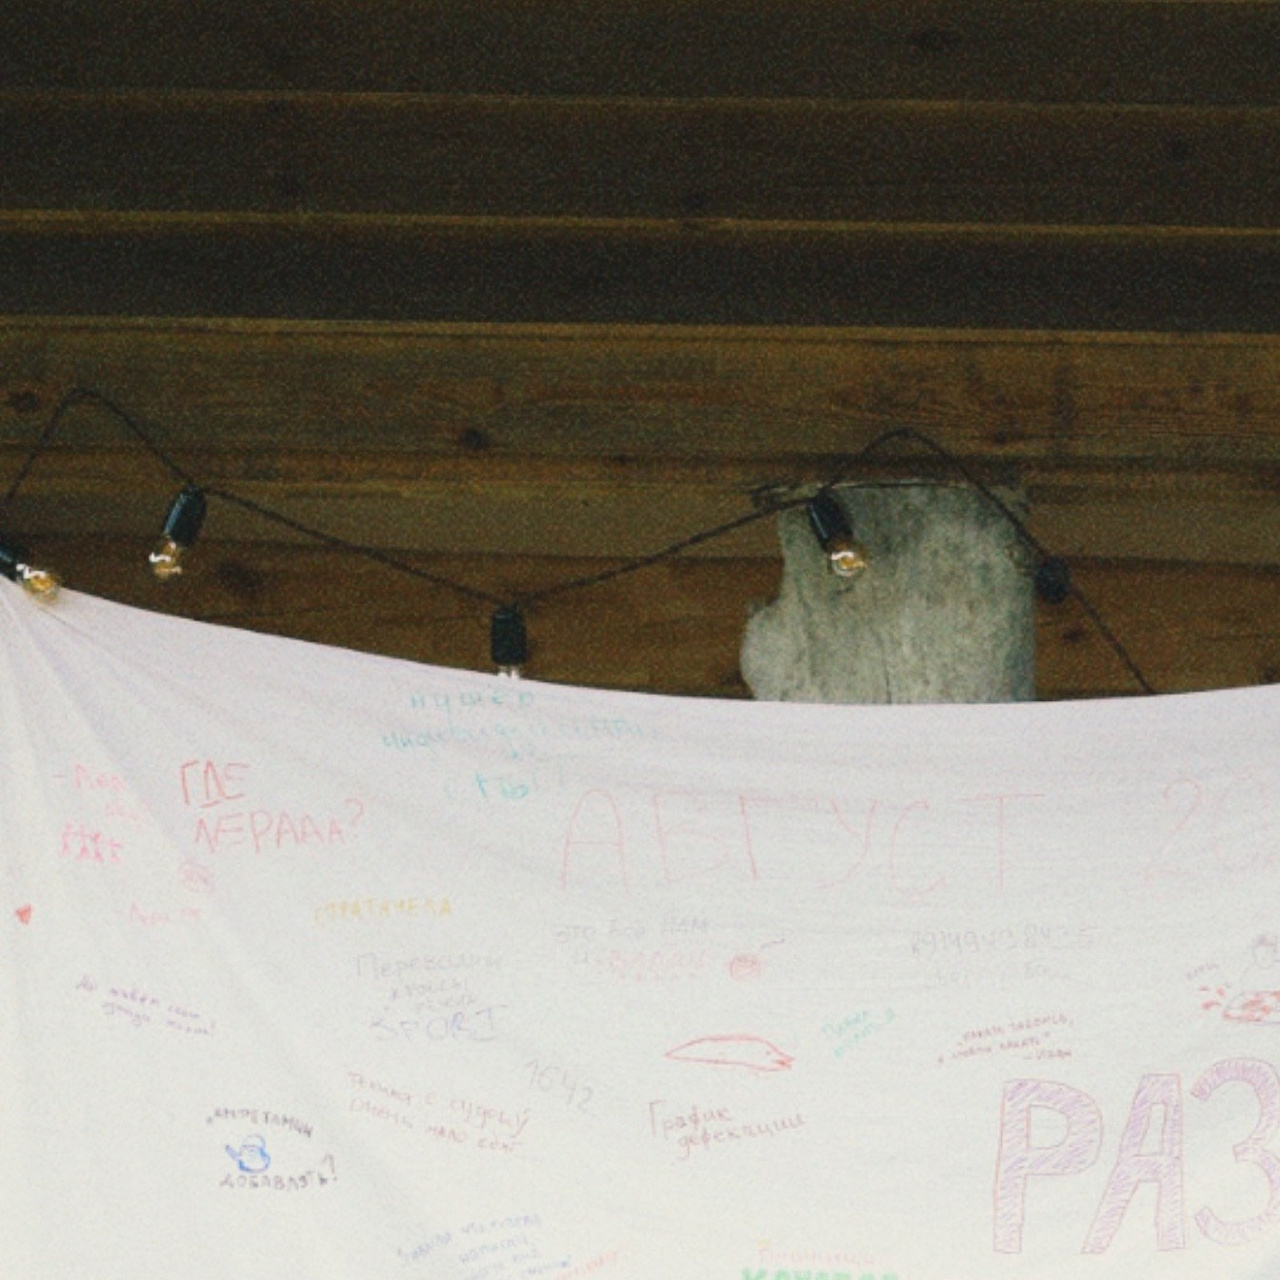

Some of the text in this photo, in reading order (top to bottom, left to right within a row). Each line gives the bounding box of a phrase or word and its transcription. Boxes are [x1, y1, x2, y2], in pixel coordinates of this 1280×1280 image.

[180, 758, 250, 808] ГДЕ
[561, 787, 1045, 898] АВГУСТ
[648, 1098, 734, 1141] График
[675, 1113, 806, 1162] дефекации
